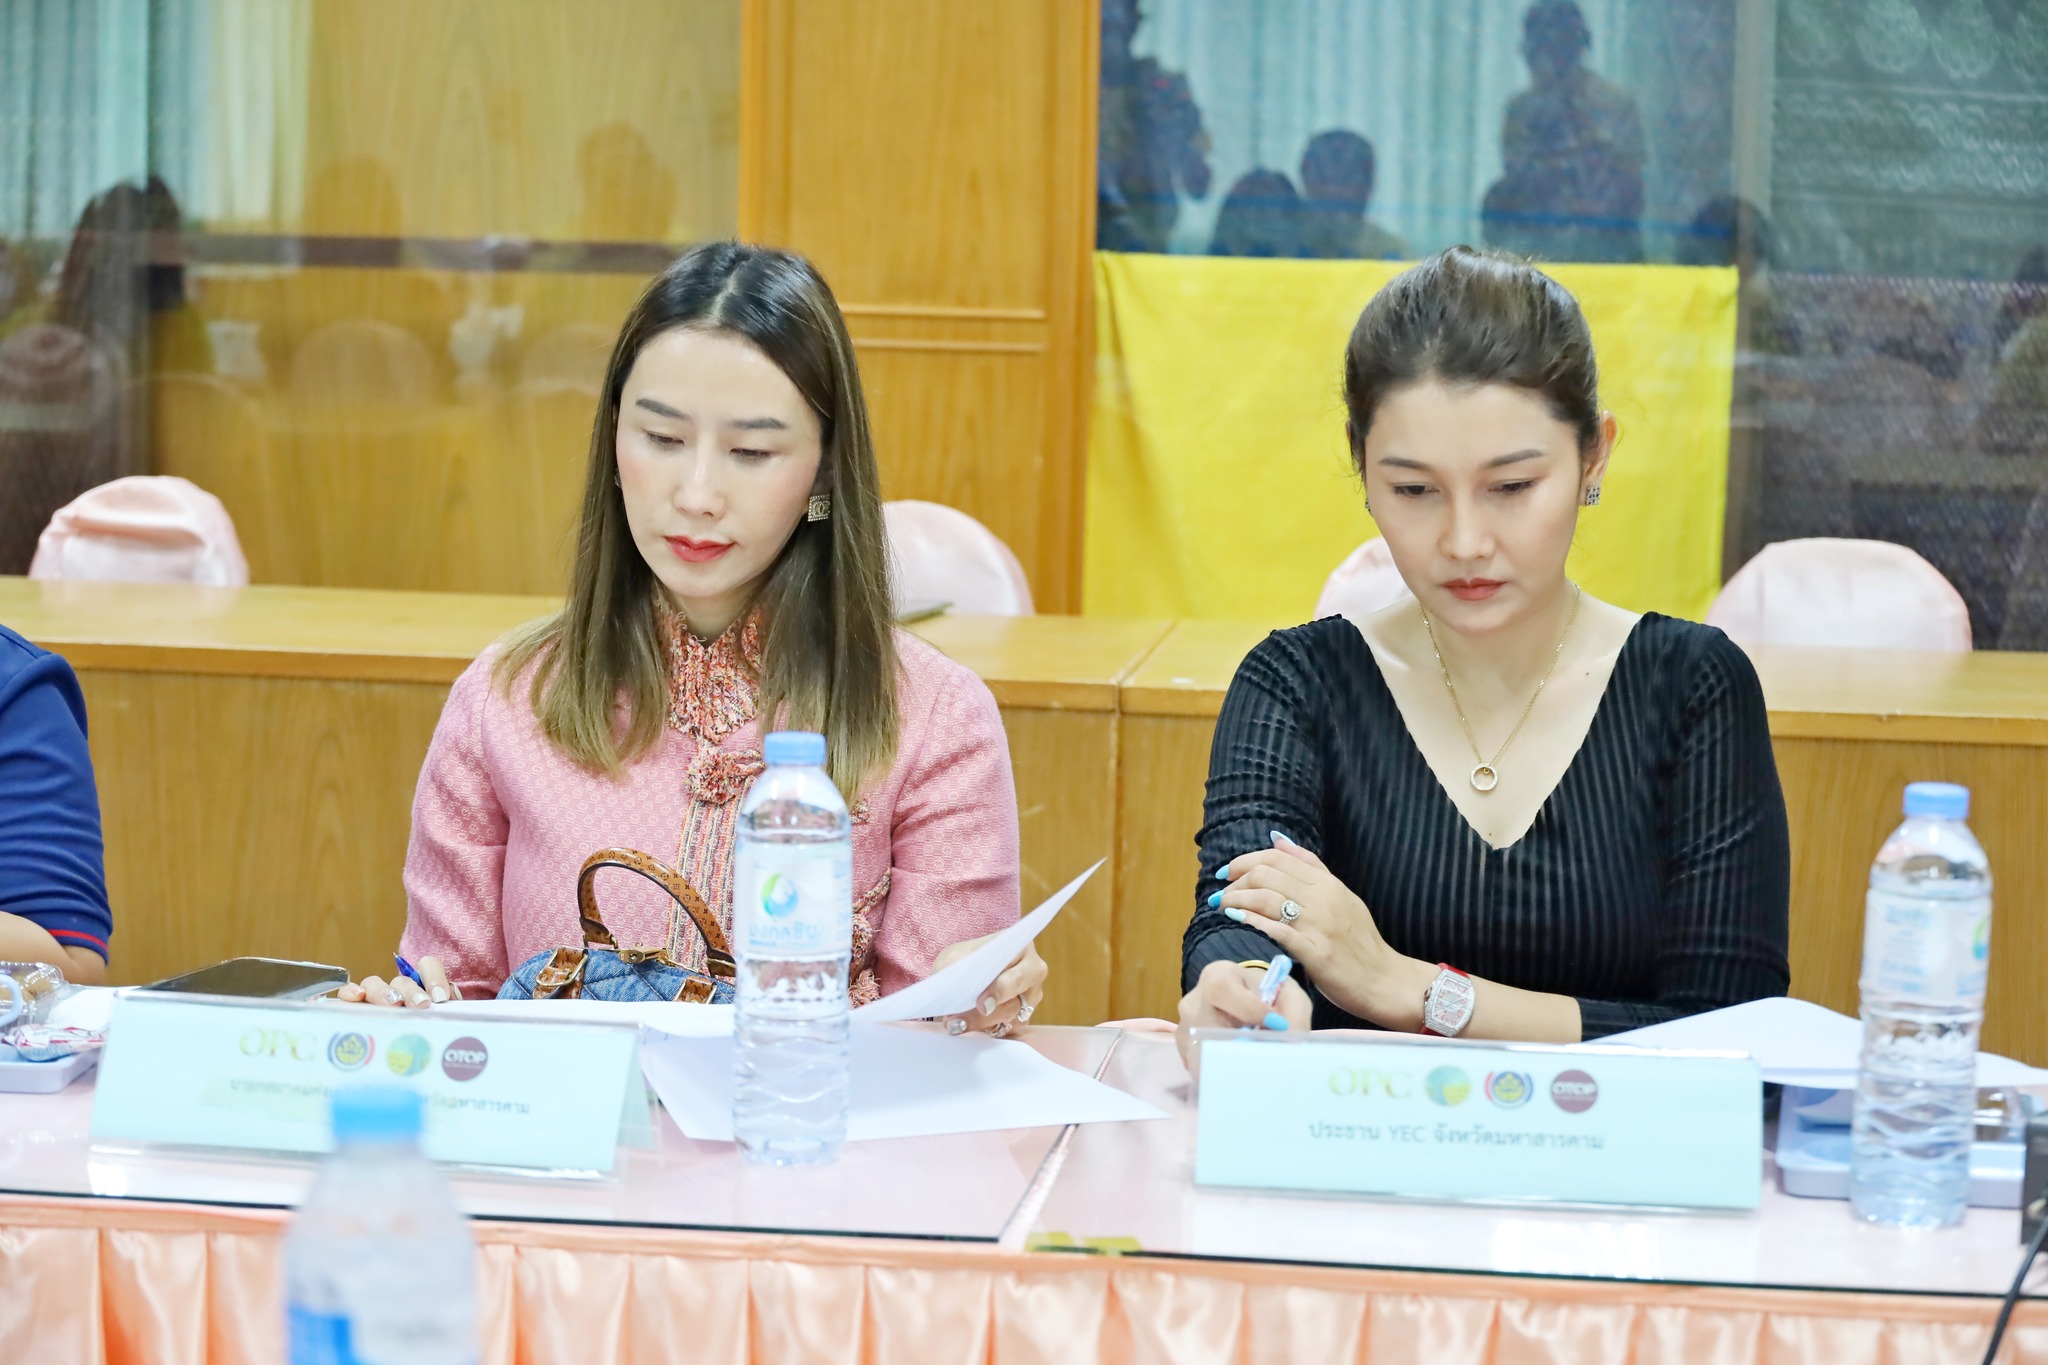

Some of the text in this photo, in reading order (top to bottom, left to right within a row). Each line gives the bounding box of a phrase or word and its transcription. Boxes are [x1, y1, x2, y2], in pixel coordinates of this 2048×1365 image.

[239, 1026, 318, 1062] OPC
[444, 1048, 487, 1065] OTOP
[1328, 1067, 1412, 1098] OPC
[1308, 1119, 1605, 1150] ประธาน YEC จังหวัดมหาสารคาม
